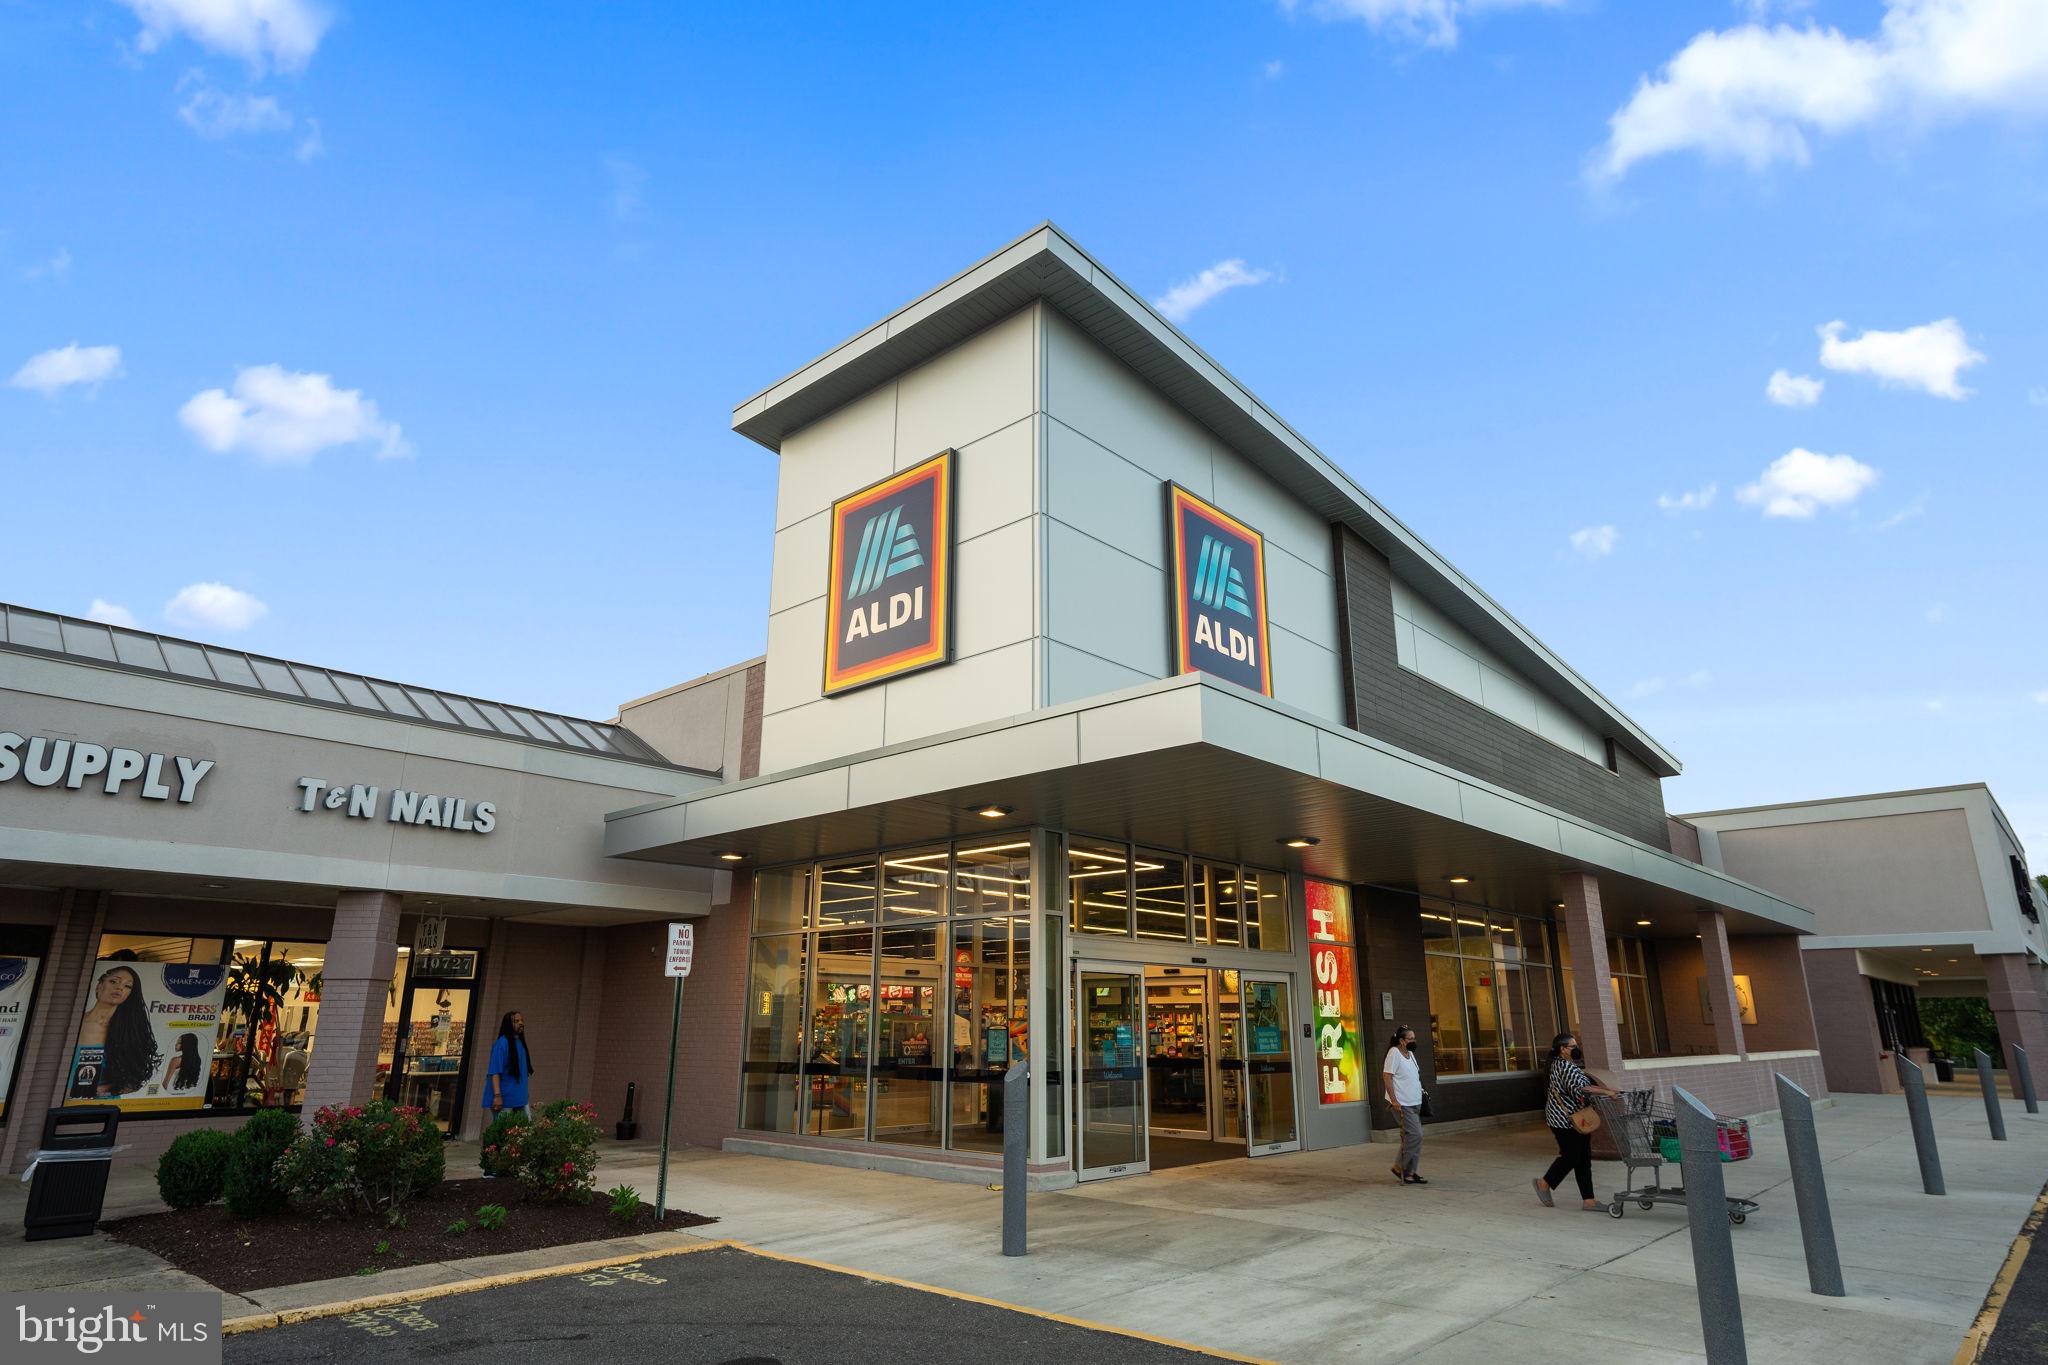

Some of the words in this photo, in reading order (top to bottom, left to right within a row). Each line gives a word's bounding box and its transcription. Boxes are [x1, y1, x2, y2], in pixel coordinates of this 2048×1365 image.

[845, 585, 924, 644] ALDI
[1194, 613, 1256, 667] ALDI
[0, 731, 216, 803] SUPPLY
[297, 776, 379, 819] T&N
[388, 789, 497, 834] NAILS
[418, 935, 439, 950] NAILS
[678, 929, 690, 939] NO
[168, 977, 216, 986] SHAKE-N-GO
[421, 957, 472, 970] 10727
[1312, 908, 1347, 1095] FRESH
